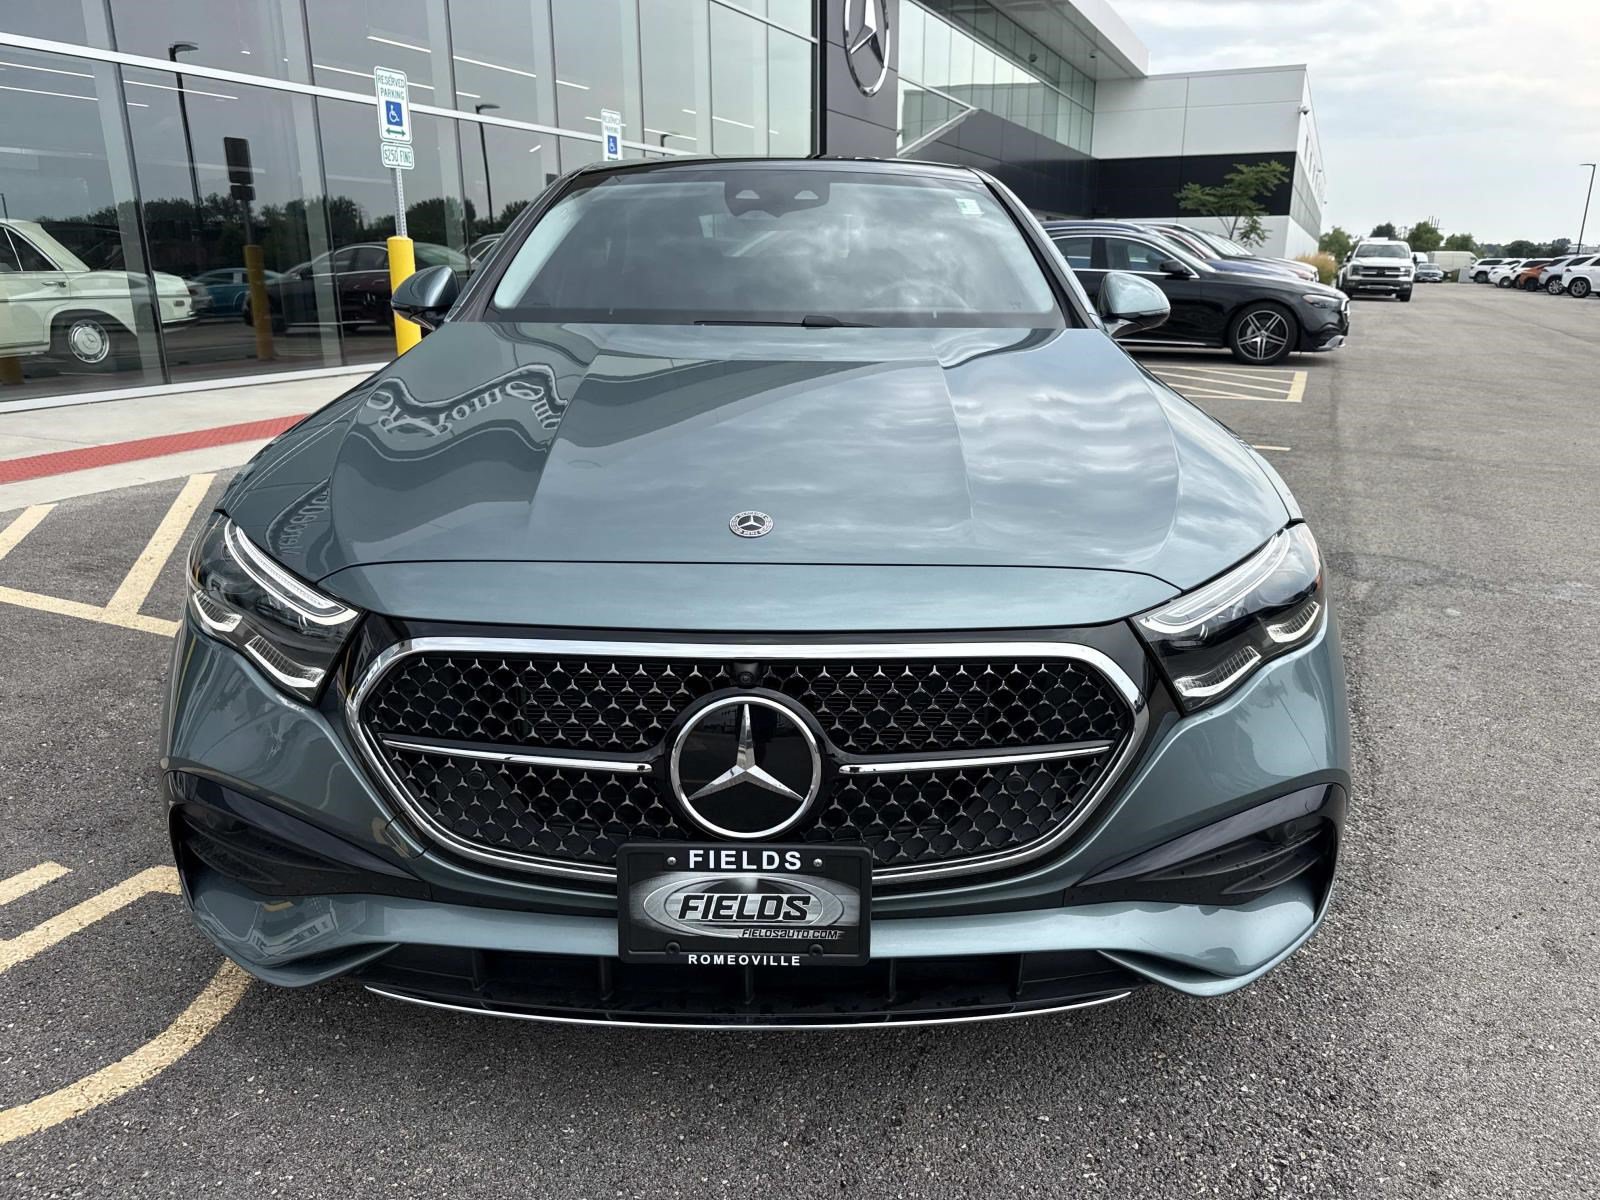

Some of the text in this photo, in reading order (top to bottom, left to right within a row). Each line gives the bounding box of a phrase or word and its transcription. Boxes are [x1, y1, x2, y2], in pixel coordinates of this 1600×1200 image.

[377, 75, 405, 88] RESERVED
[380, 88, 405, 100] PARKING
[399, 151, 411, 163] FINE
[689, 850, 801, 870] FIELDS
[678, 894, 811, 921] FIELDS
[688, 954, 800, 966] ROMEOVILLE
